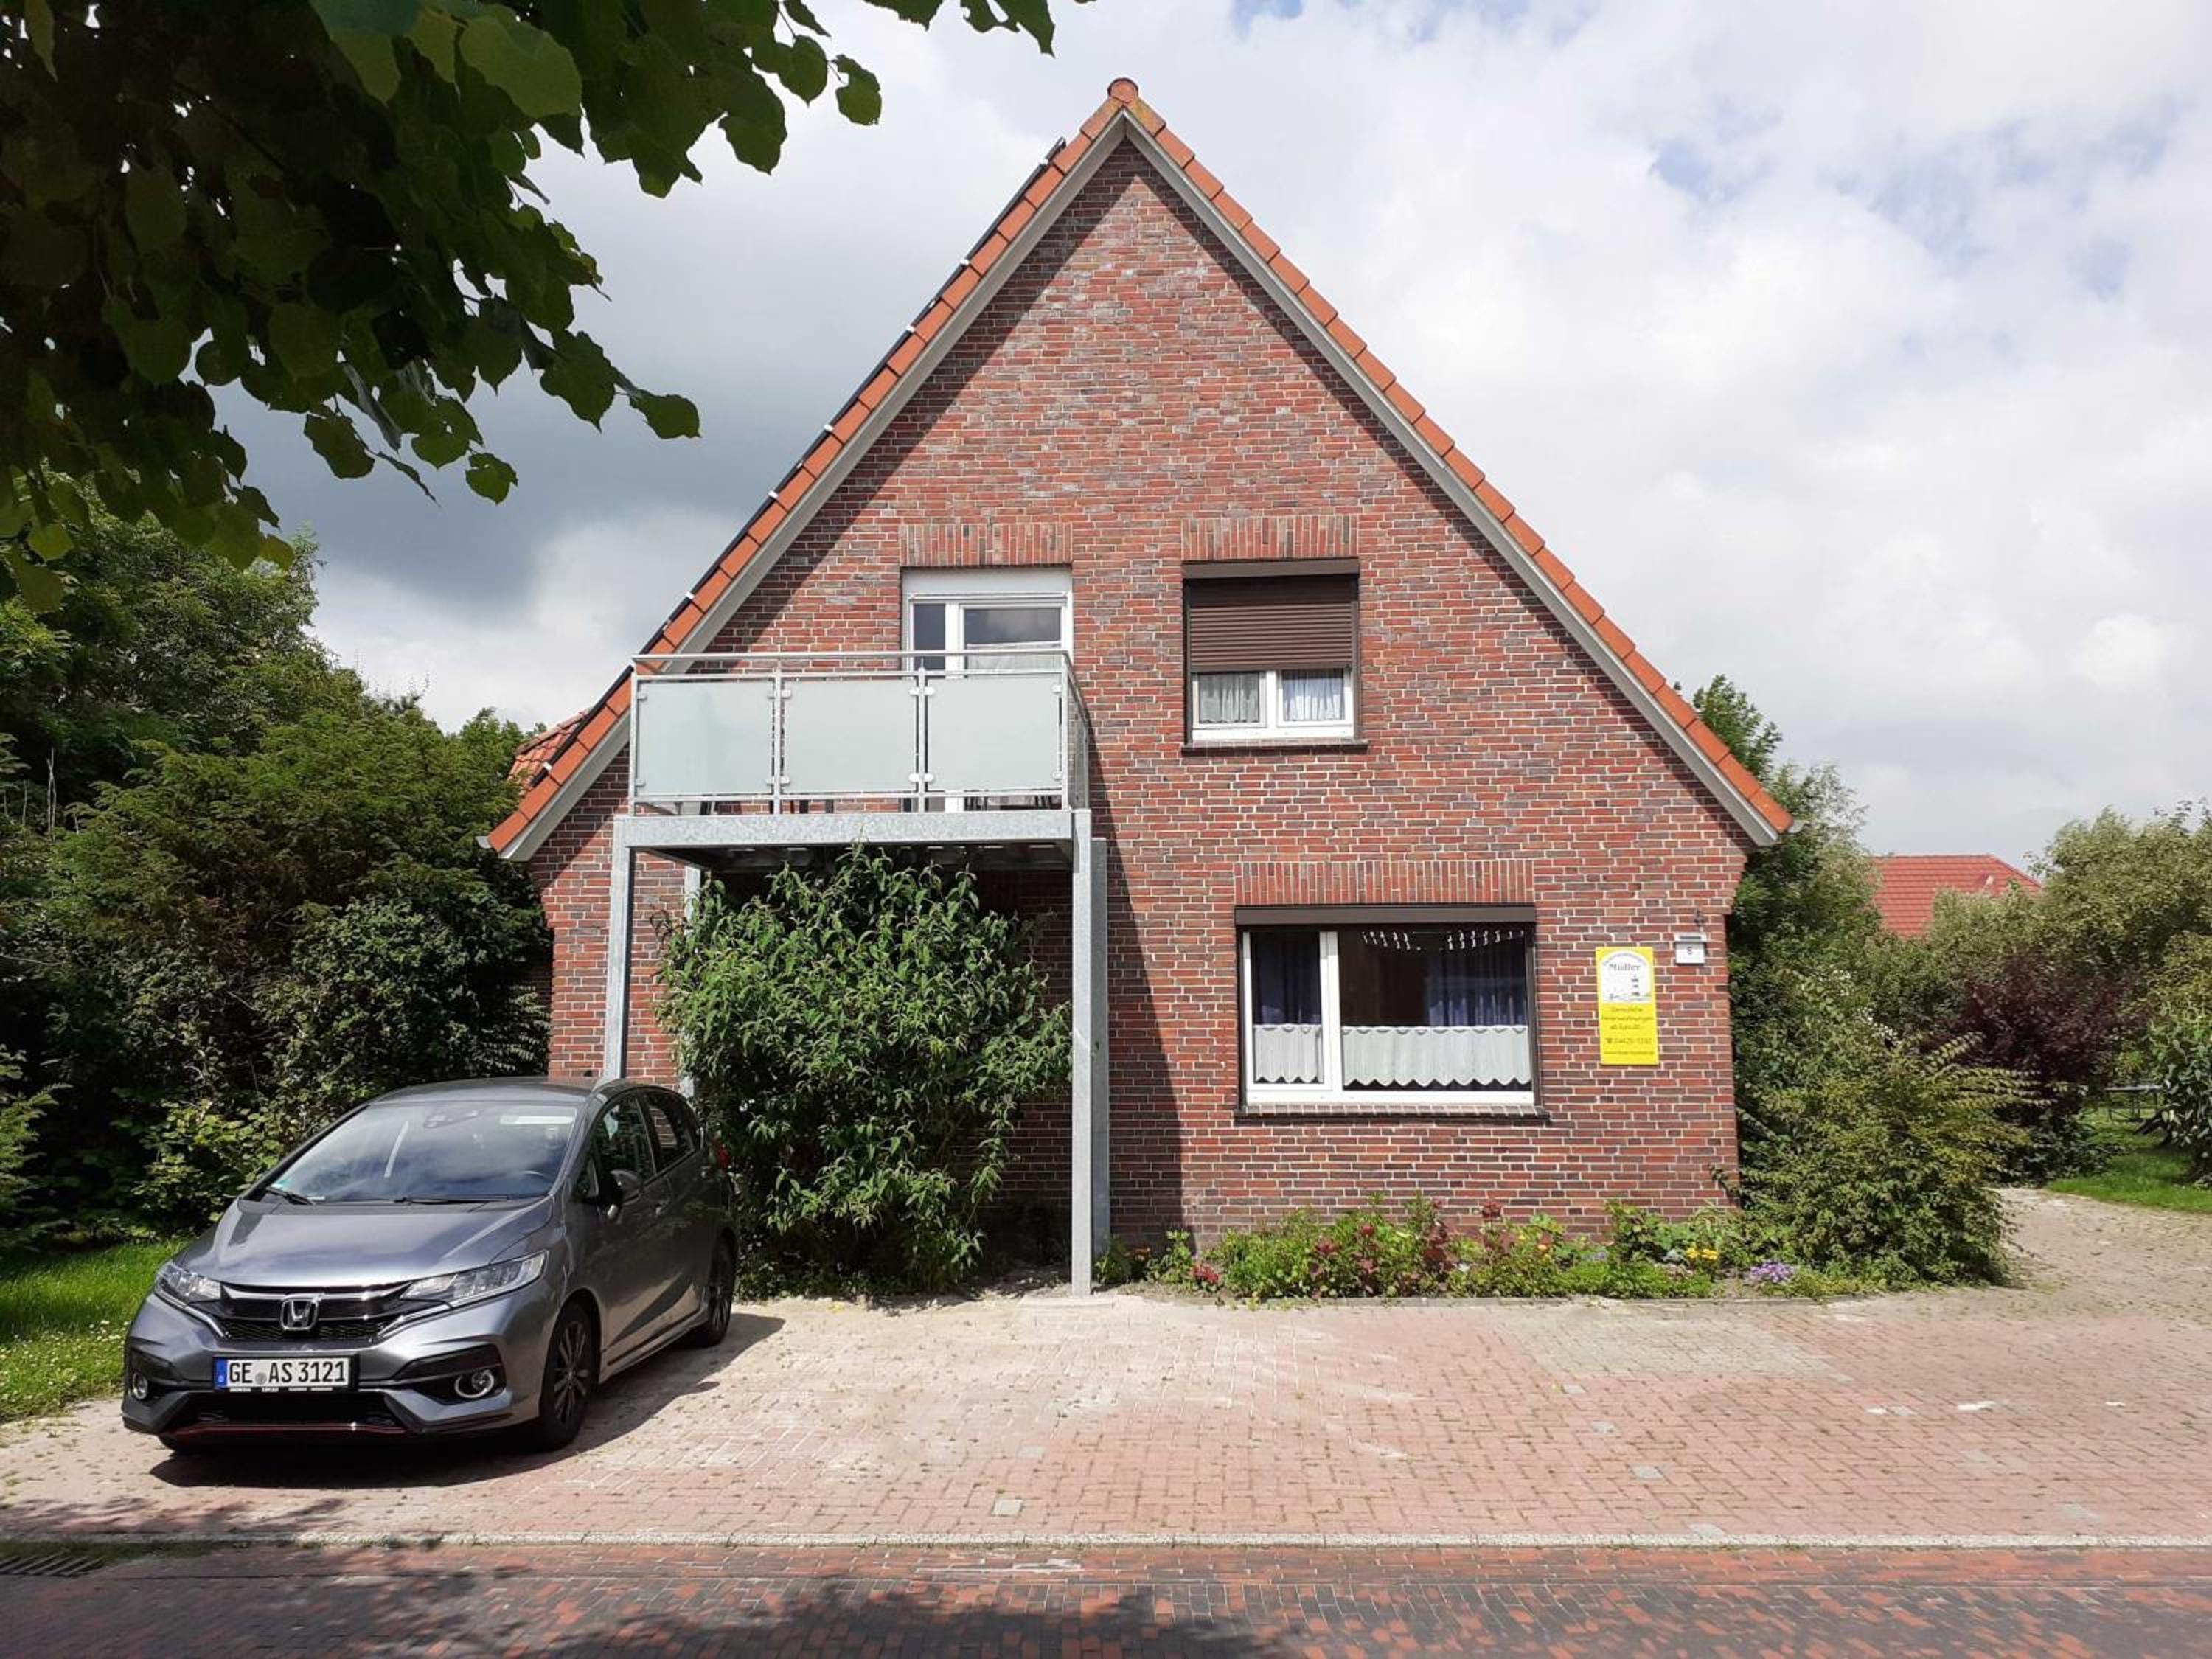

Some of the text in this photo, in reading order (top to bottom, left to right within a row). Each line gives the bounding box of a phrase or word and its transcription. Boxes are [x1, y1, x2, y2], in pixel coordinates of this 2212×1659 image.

[229, 1361, 345, 1384] GE AS 3121
